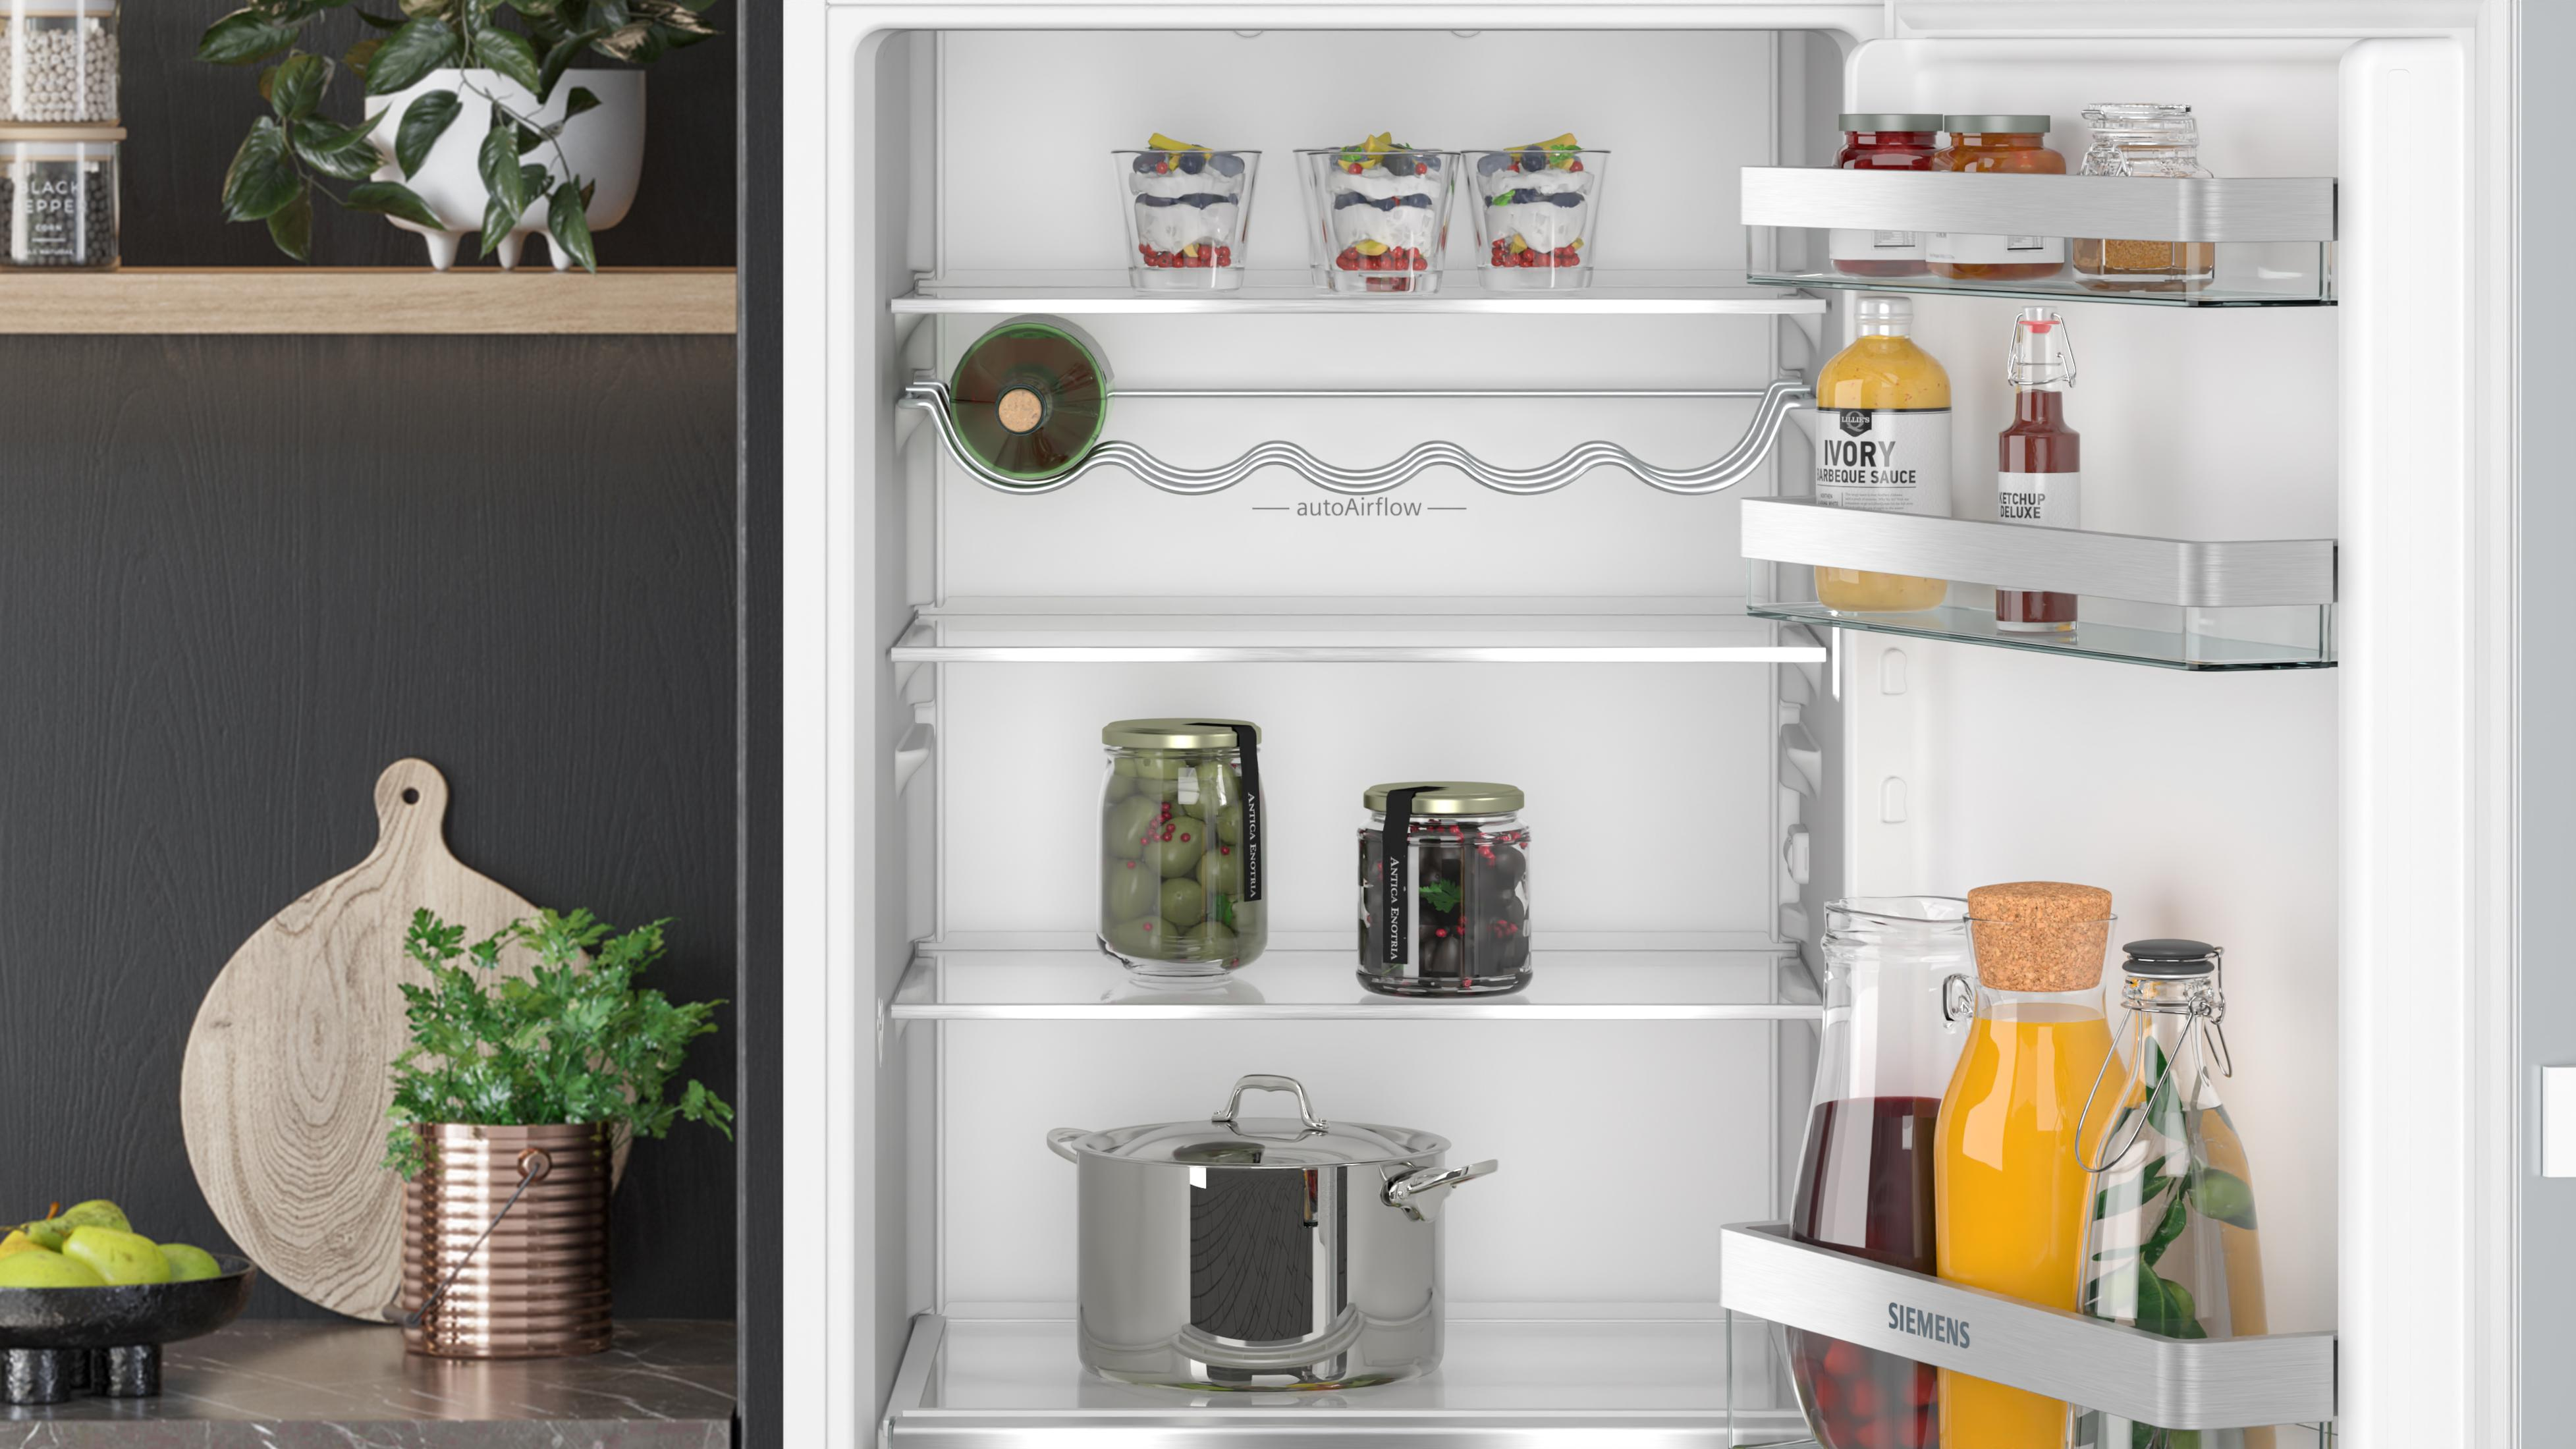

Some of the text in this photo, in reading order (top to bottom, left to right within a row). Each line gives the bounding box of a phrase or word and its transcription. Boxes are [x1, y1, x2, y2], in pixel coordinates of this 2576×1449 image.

[1824, 439, 1896, 467] IVORY
[1871, 470, 1916, 483] SAUCE
[1297, 497, 1421, 516] autoAirflow
[1999, 491, 2045, 505] KETCHUP
[2000, 505, 2041, 519] DELUXE
[1248, 792, 1257, 840] ANTICA
[1390, 856, 1399, 960] ANTICA ENOTRIA
[1888, 1302, 1970, 1349] SIEMENS
